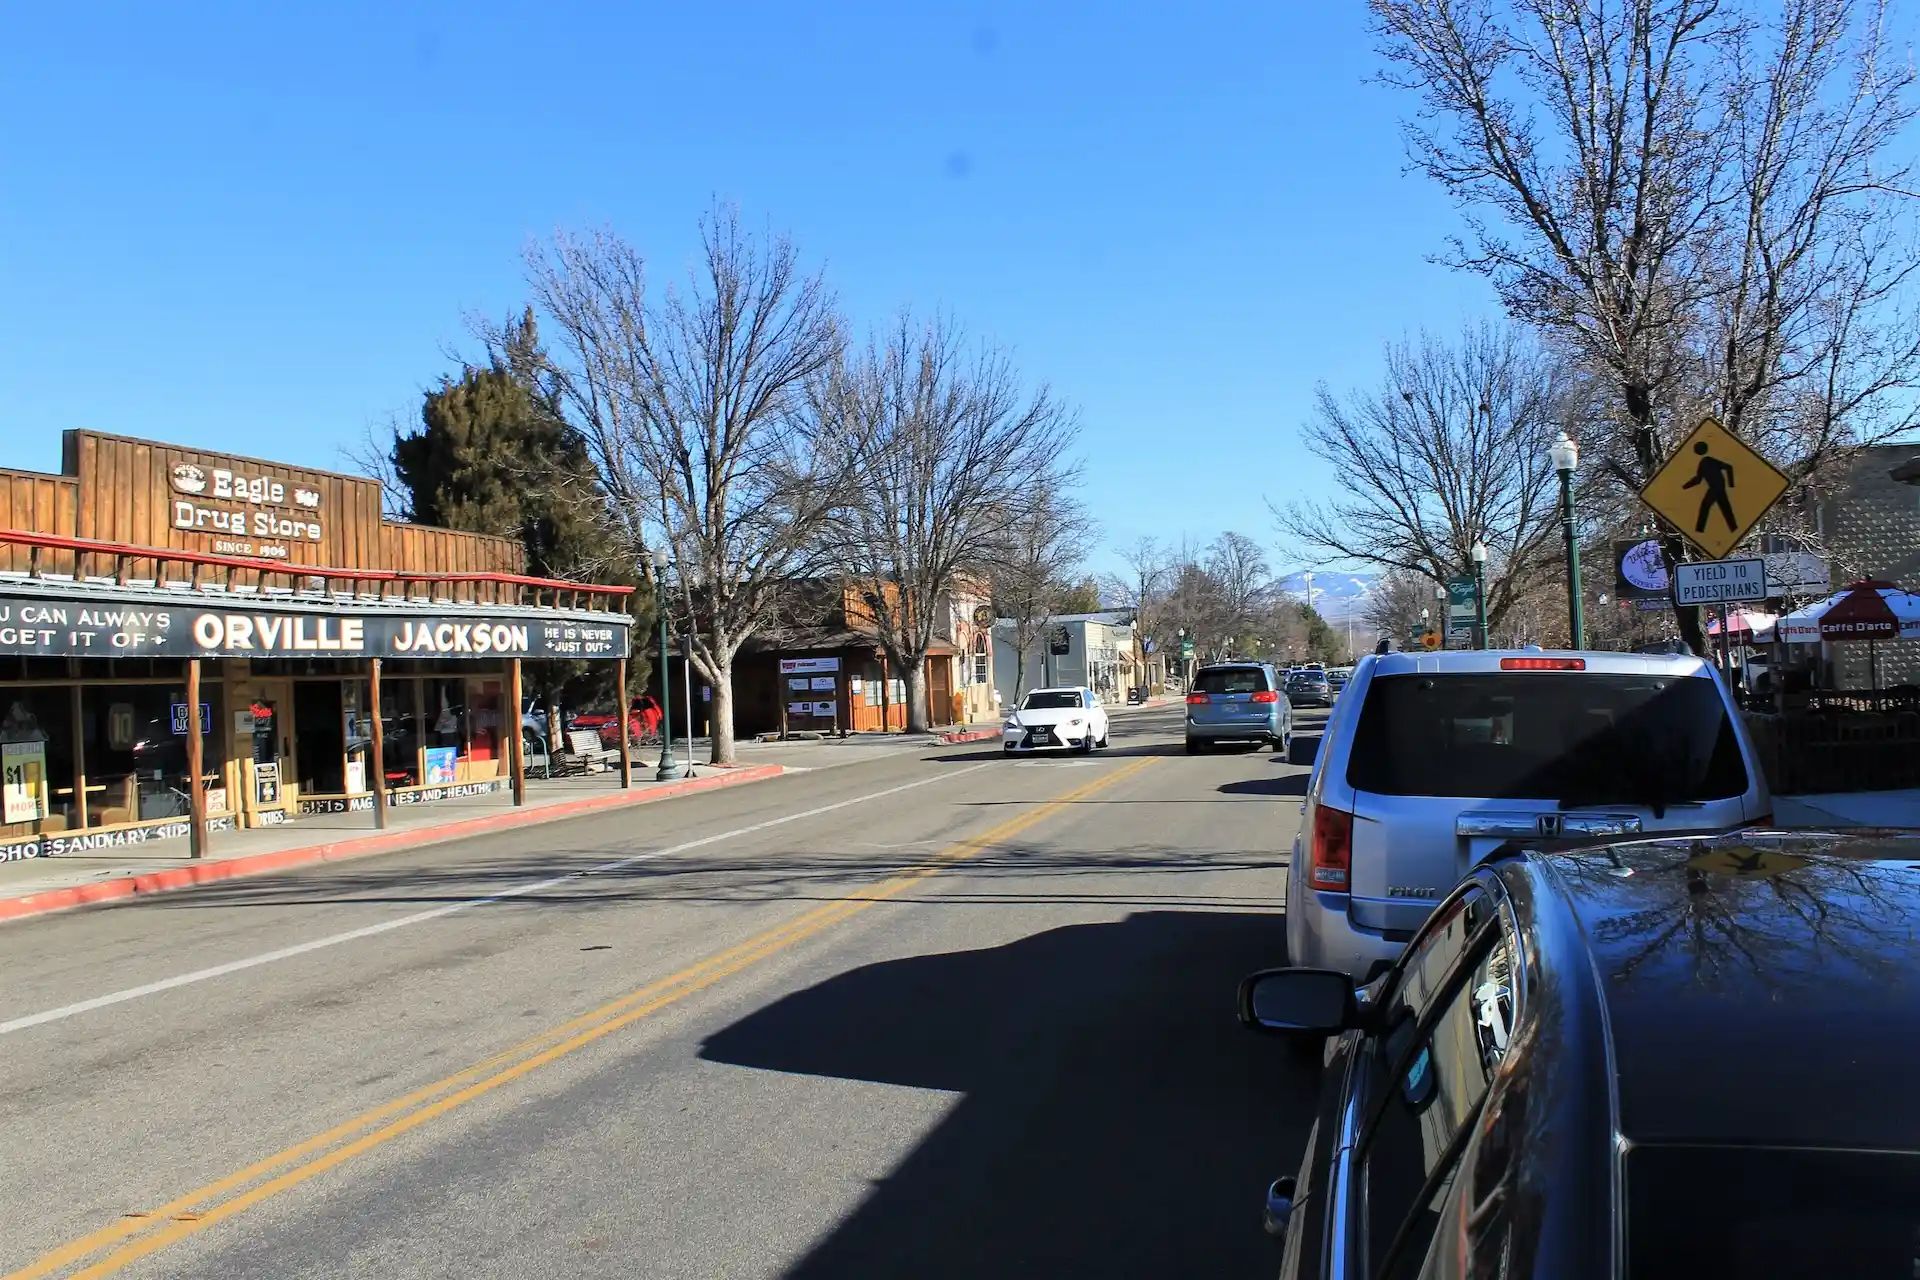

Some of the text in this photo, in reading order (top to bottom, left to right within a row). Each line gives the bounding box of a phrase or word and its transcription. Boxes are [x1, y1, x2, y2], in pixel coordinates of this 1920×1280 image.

[212, 469, 285, 504] Eagle
[174, 501, 321, 540] Drug Store
[215, 540, 287, 558] SINCE 1906
[1693, 564, 1747, 581] YIELD TO
[1683, 582, 1760, 600] PEDESTRIANS
[20, 607, 67, 626] CAN
[77, 609, 171, 628] ALWAYS
[1856, 622, 1892, 631] D'arte
[0, 628, 146, 648] GET IT OF
[193, 612, 365, 652] ORVILLE
[394, 621, 529, 653] JACKSON
[544, 627, 613, 641] HE IS NEVER
[554, 641, 604, 653] JUST OUT
